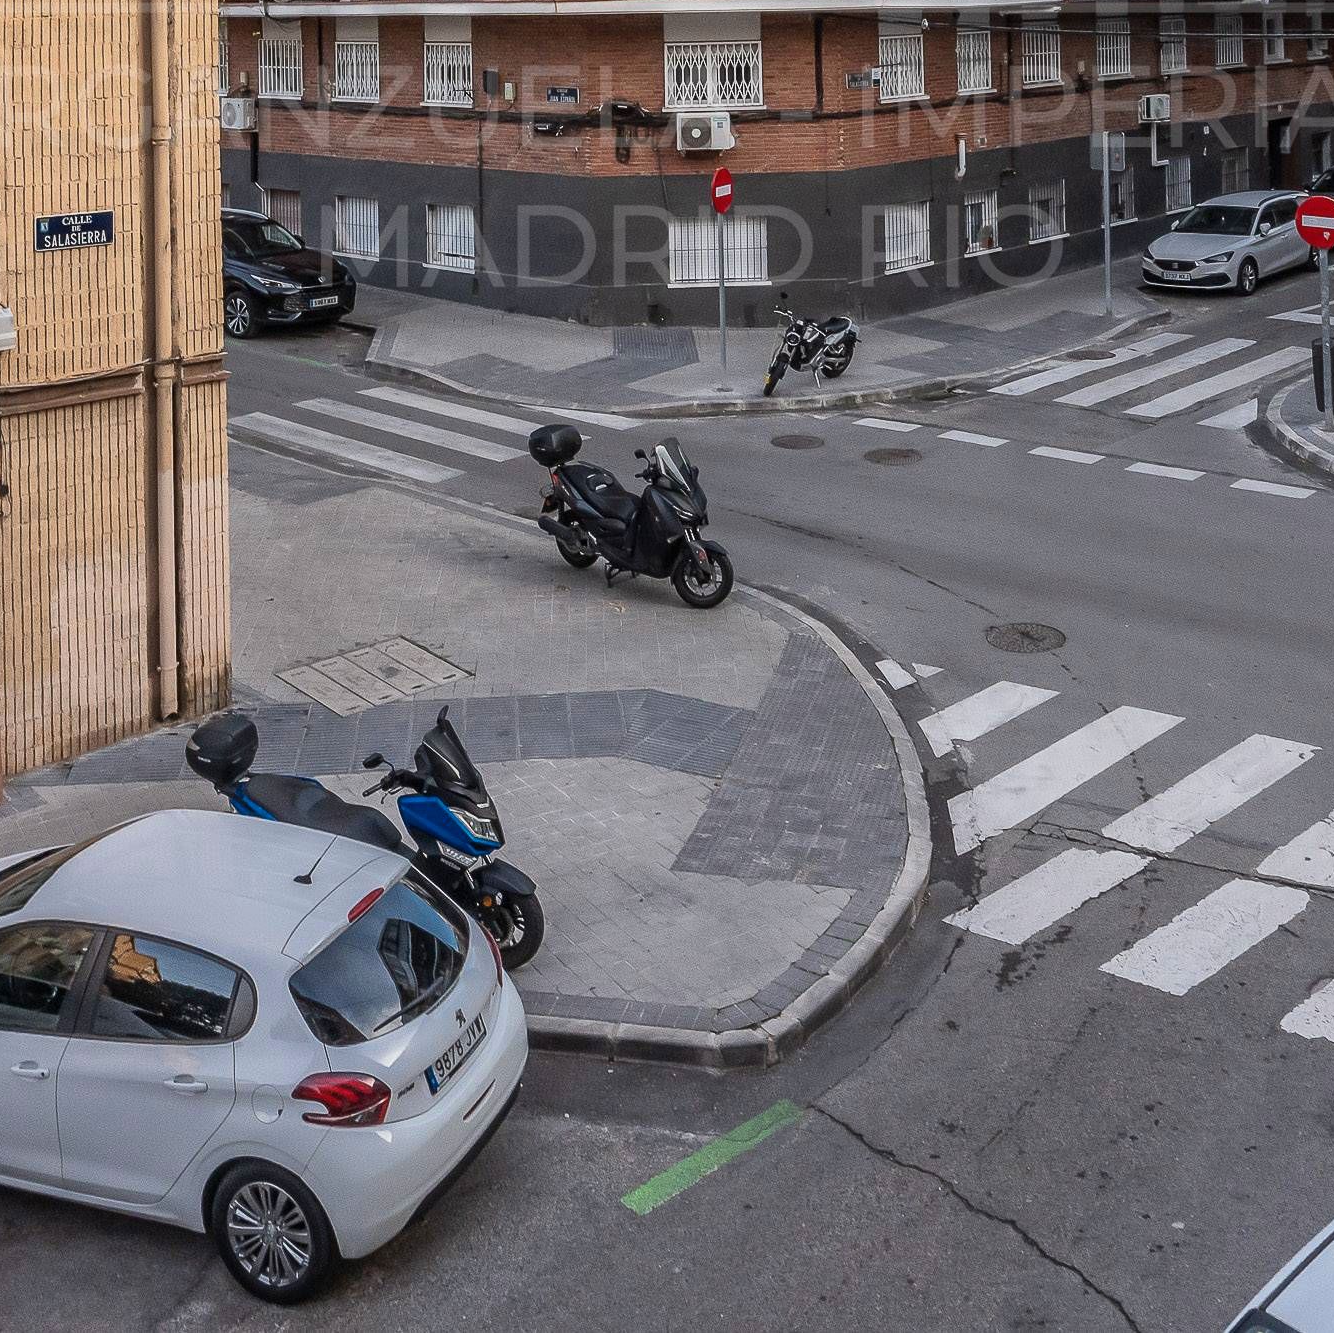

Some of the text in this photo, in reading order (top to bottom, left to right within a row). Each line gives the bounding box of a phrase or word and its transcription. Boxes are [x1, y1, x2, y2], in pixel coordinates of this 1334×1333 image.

[61, 215, 93, 226] CALLE
[44, 230, 107, 248] SALASIERRA
[435, 1039, 464, 1078] 9878
